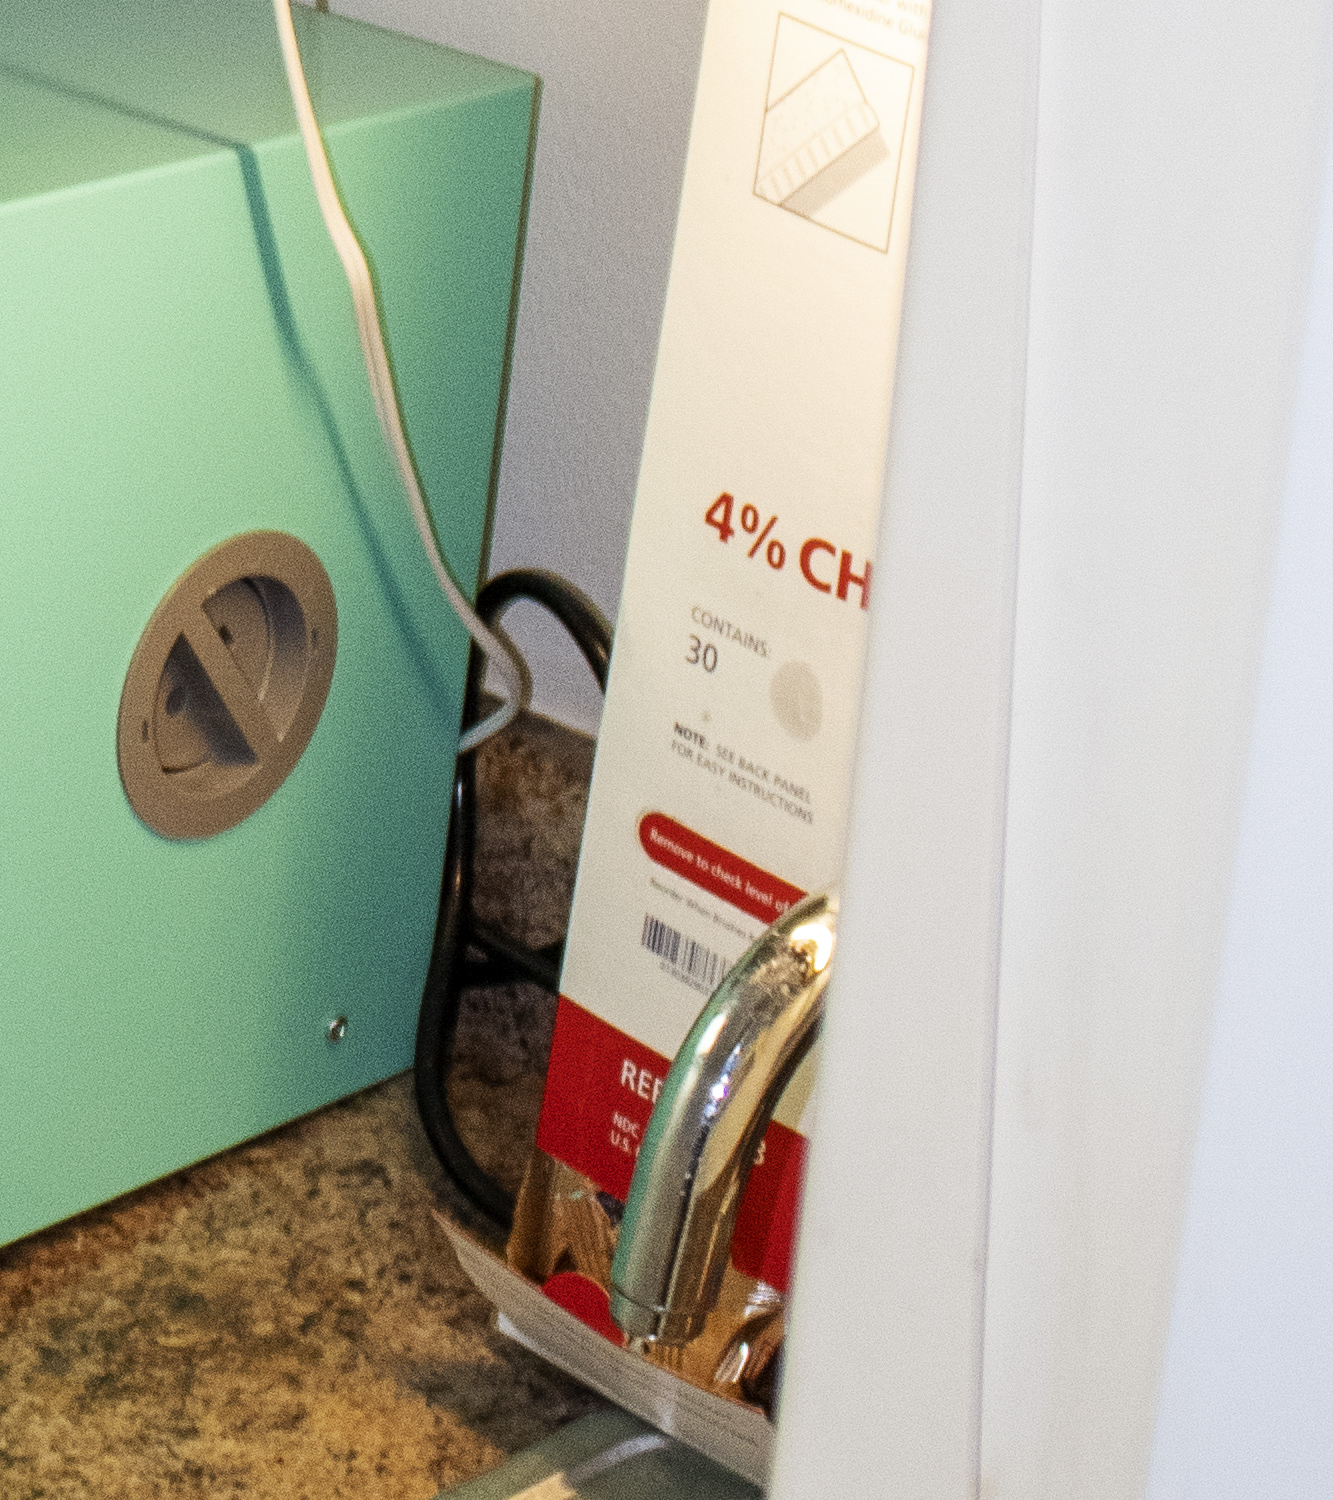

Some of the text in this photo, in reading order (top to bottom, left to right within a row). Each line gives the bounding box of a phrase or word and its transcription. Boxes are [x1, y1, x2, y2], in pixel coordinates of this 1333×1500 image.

[704, 491, 874, 612] 4% CH
[685, 633, 719, 674] 30
[670, 738, 815, 826] FOR EASY INSTRUCTIONS
[738, 755, 771, 783] BACK
[772, 773, 812, 805] PANEL
[649, 826, 695, 864] Remove
